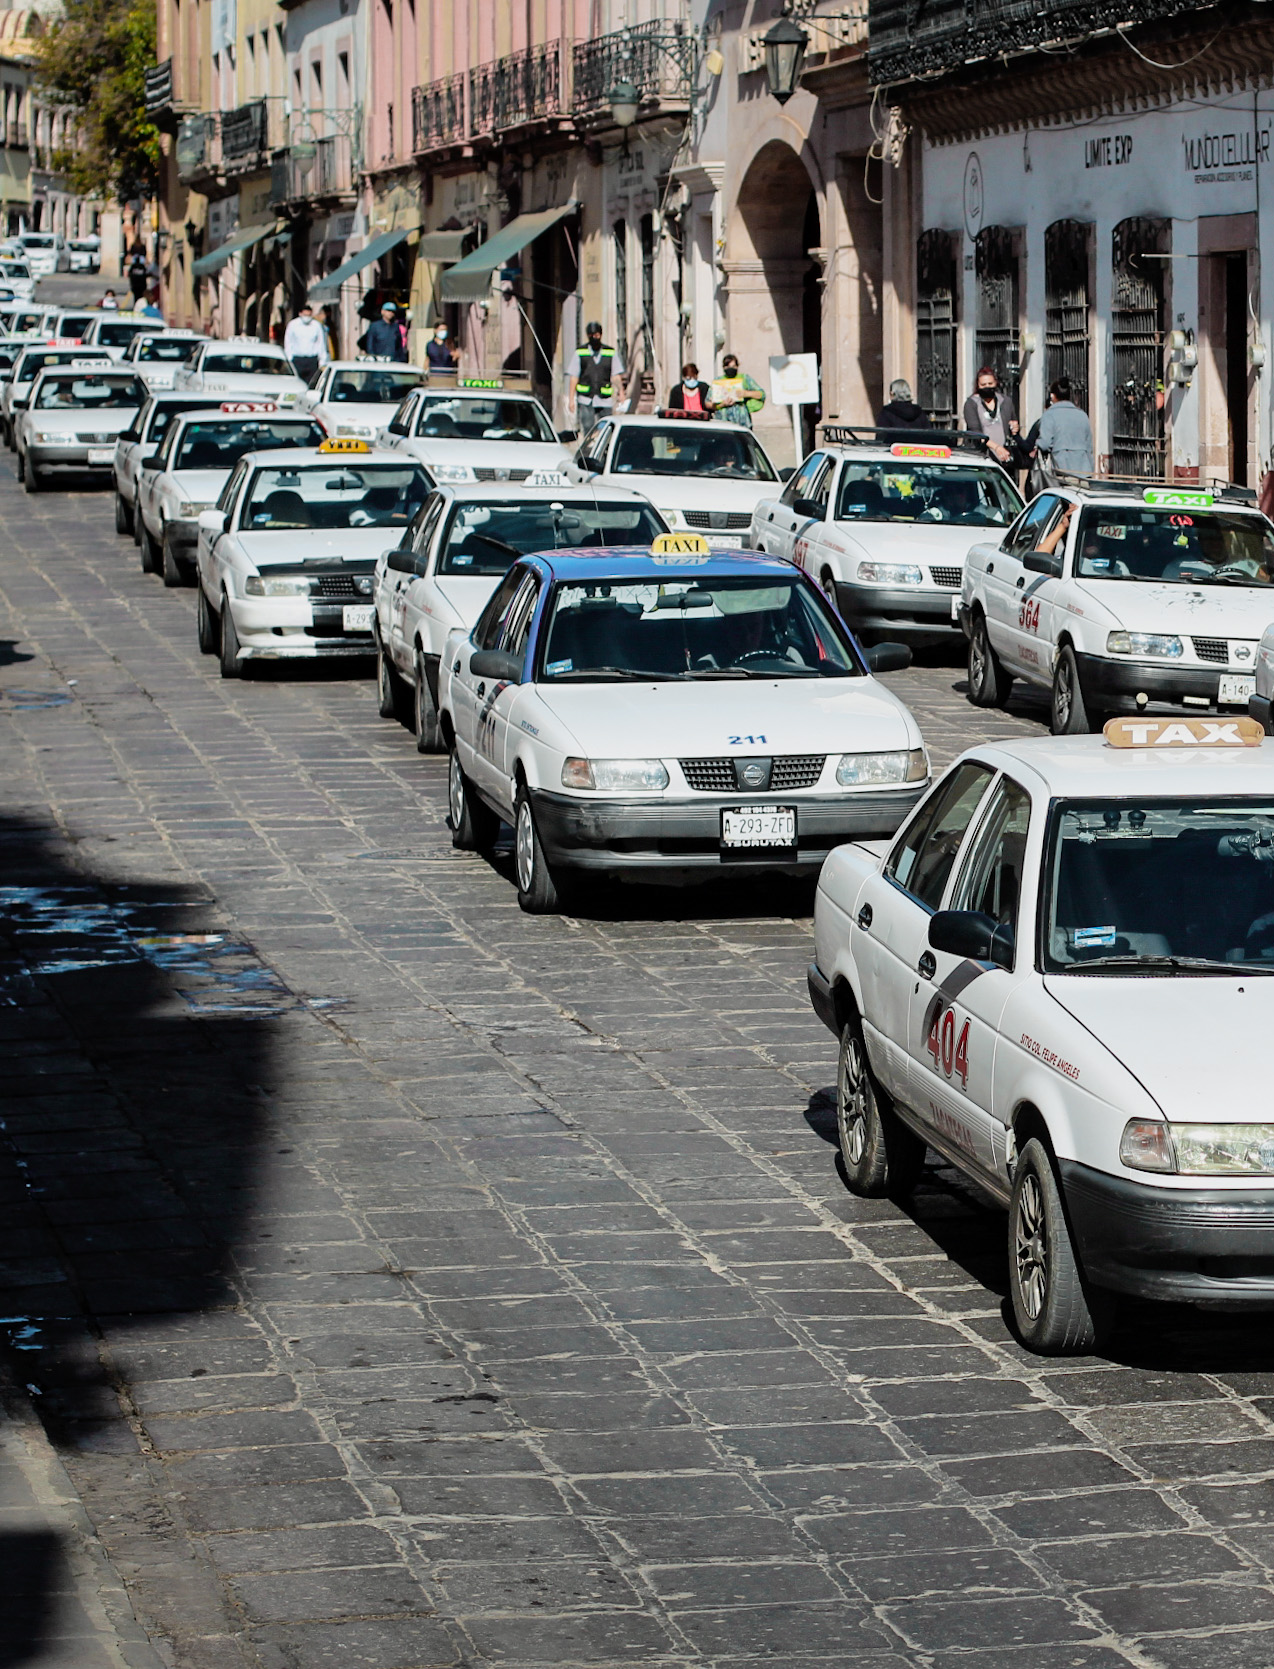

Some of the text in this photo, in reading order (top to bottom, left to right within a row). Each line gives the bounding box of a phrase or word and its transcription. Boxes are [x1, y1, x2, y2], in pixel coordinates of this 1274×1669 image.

[1085, 135, 1133, 169] LIMITE EXP
[465, 379, 498, 388] TAXI
[224, 403, 276, 412] TAXI
[665, 410, 709, 420] TAXI
[899, 446, 945, 457] TAXI
[534, 474, 560, 485] TAXI
[1152, 493, 1206, 505] TAXI
[1099, 525, 1123, 538] TAXI
[660, 539, 700, 552] TAXI
[1019, 596, 1041, 635] 364
[728, 735, 767, 745] 211
[1121, 723, 1244, 744] TAX
[724, 817, 794, 834] A-293-ZFD
[927, 998, 972, 1091] 404
[1020, 1033, 1032, 1049] SITIO
[1042, 1047, 1058, 1065] FELIPE
[1057, 1058, 1080, 1080] ANGELES
